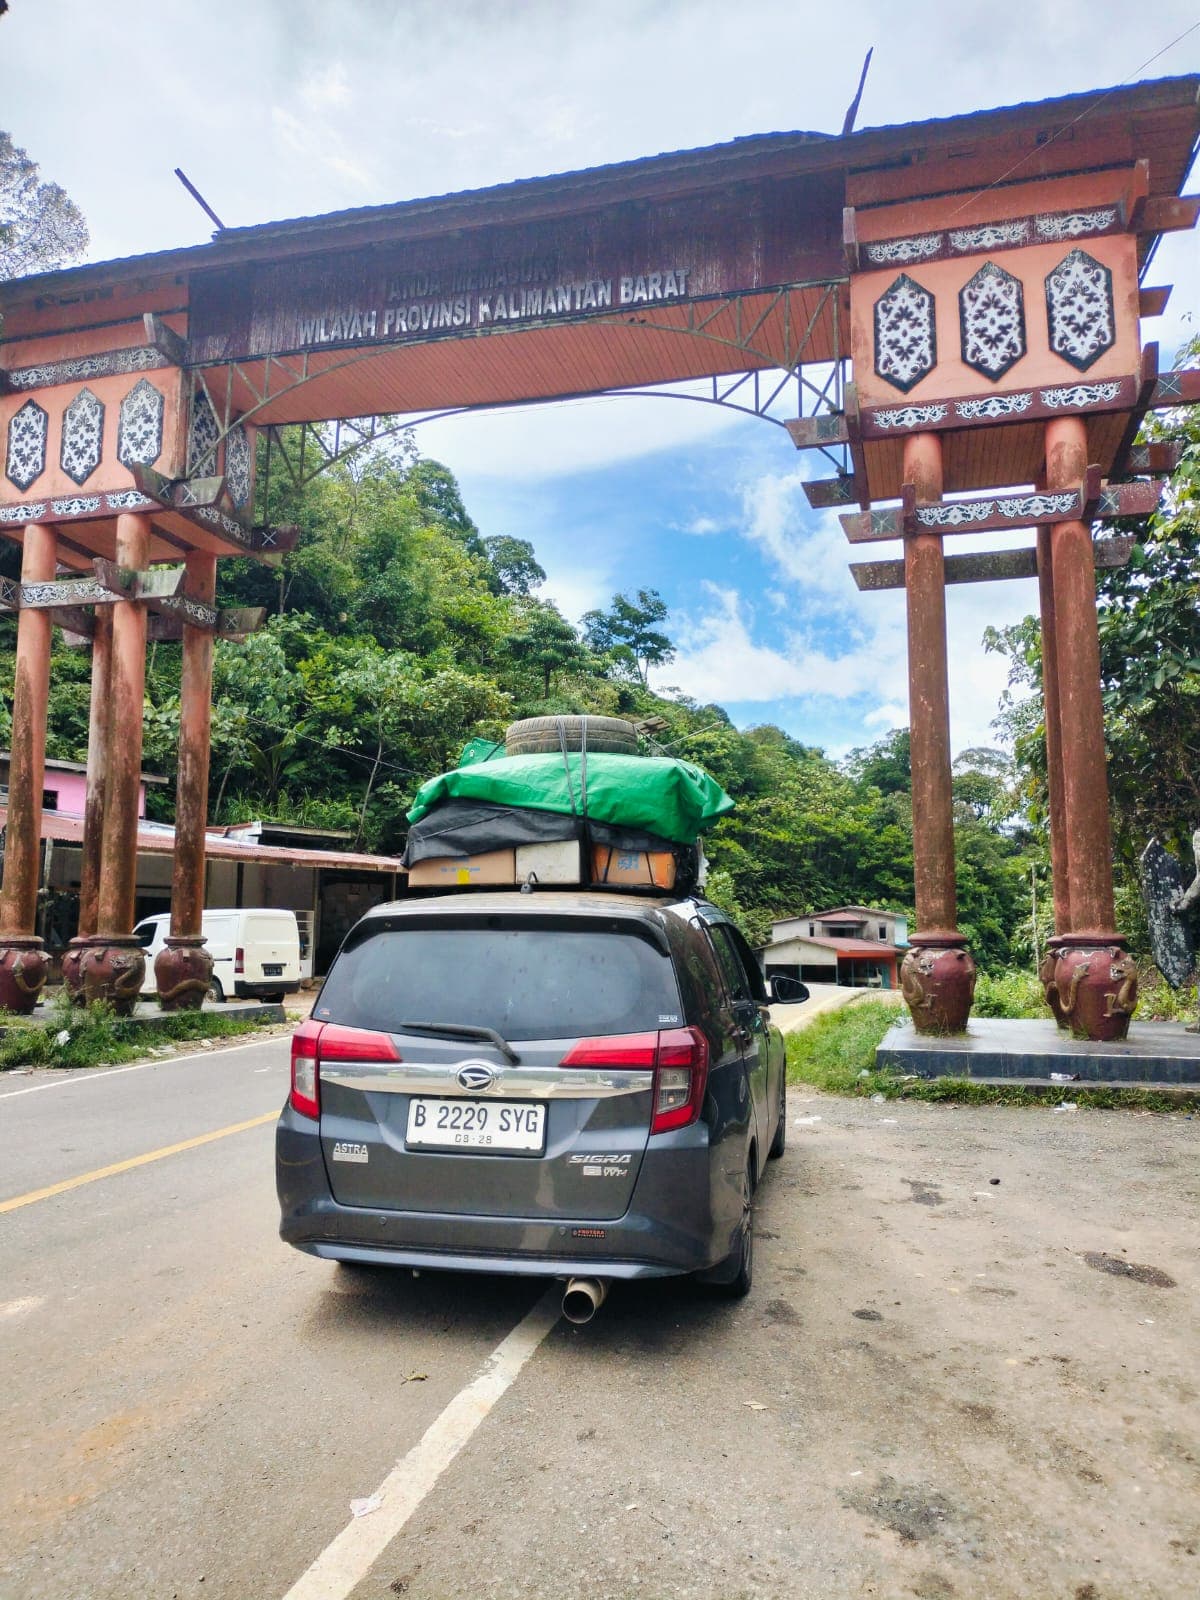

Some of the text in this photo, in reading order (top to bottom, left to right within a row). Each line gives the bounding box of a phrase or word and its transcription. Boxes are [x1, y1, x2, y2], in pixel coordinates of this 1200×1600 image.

[299, 268, 691, 345] WILAYAH PROVINSI KALIMANTAN BARAT
[414, 1104, 539, 1134] B 2229 SYG
[333, 1142, 368, 1155] ASTRA
[568, 1154, 632, 1164] SIGRA
